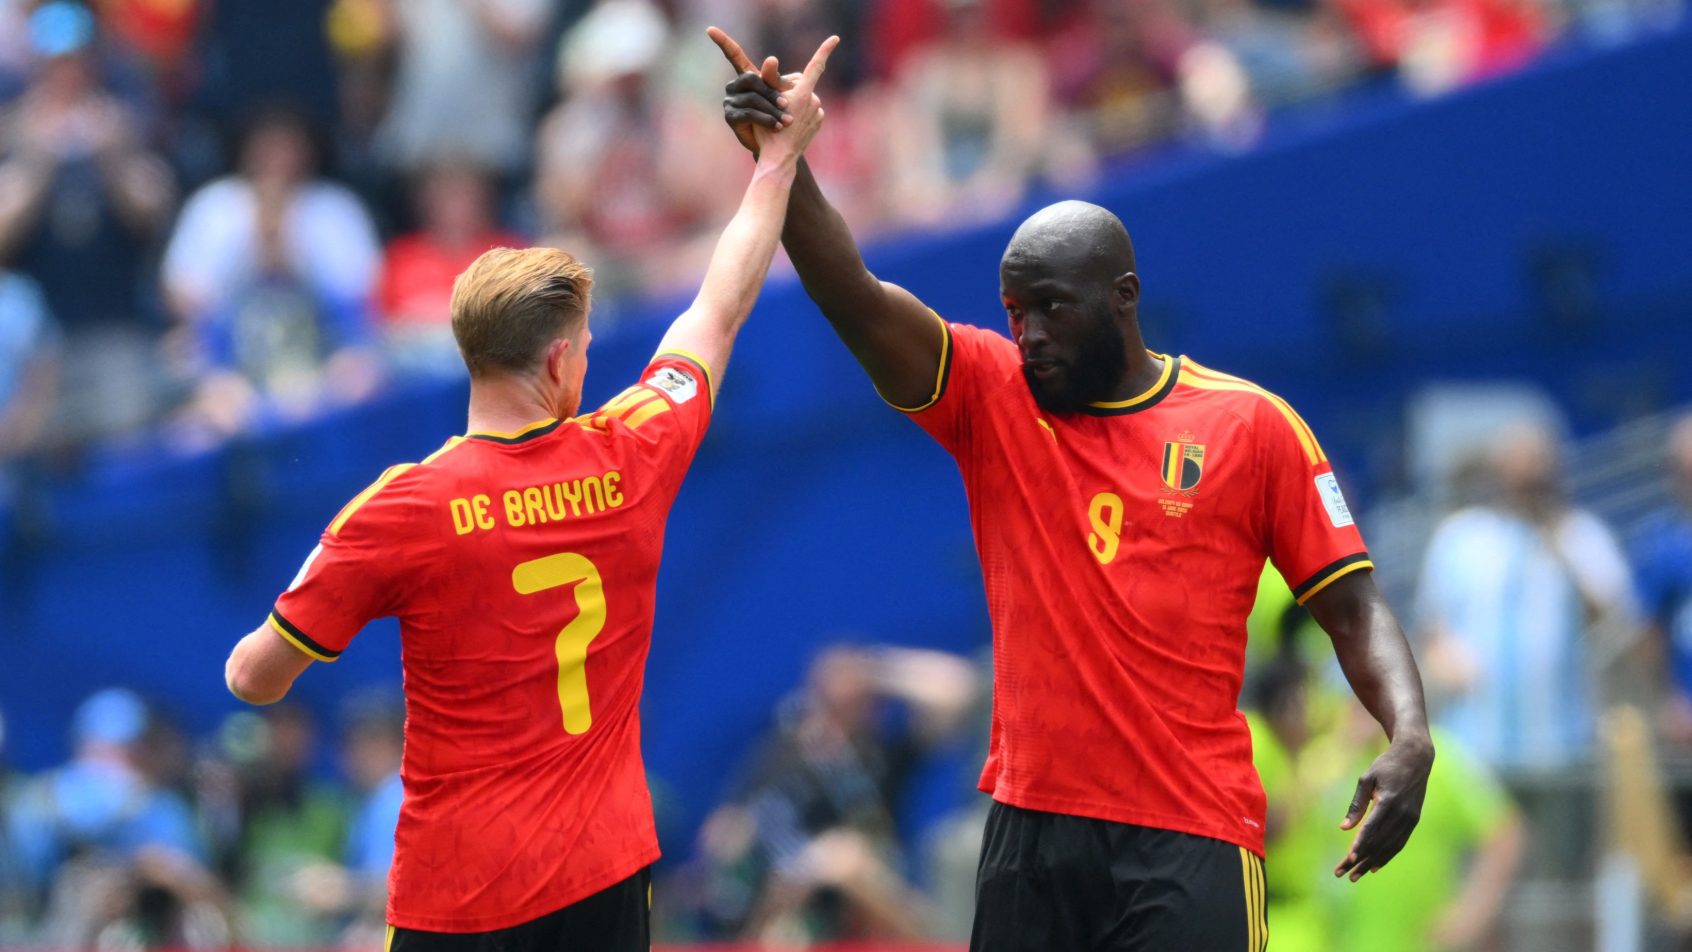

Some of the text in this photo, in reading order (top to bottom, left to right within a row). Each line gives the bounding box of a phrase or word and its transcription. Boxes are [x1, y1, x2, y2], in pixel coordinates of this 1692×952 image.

[450, 470, 625, 536] DE BRUYNE
[1087, 491, 1125, 566] 9
[511, 551, 607, 736] 7
